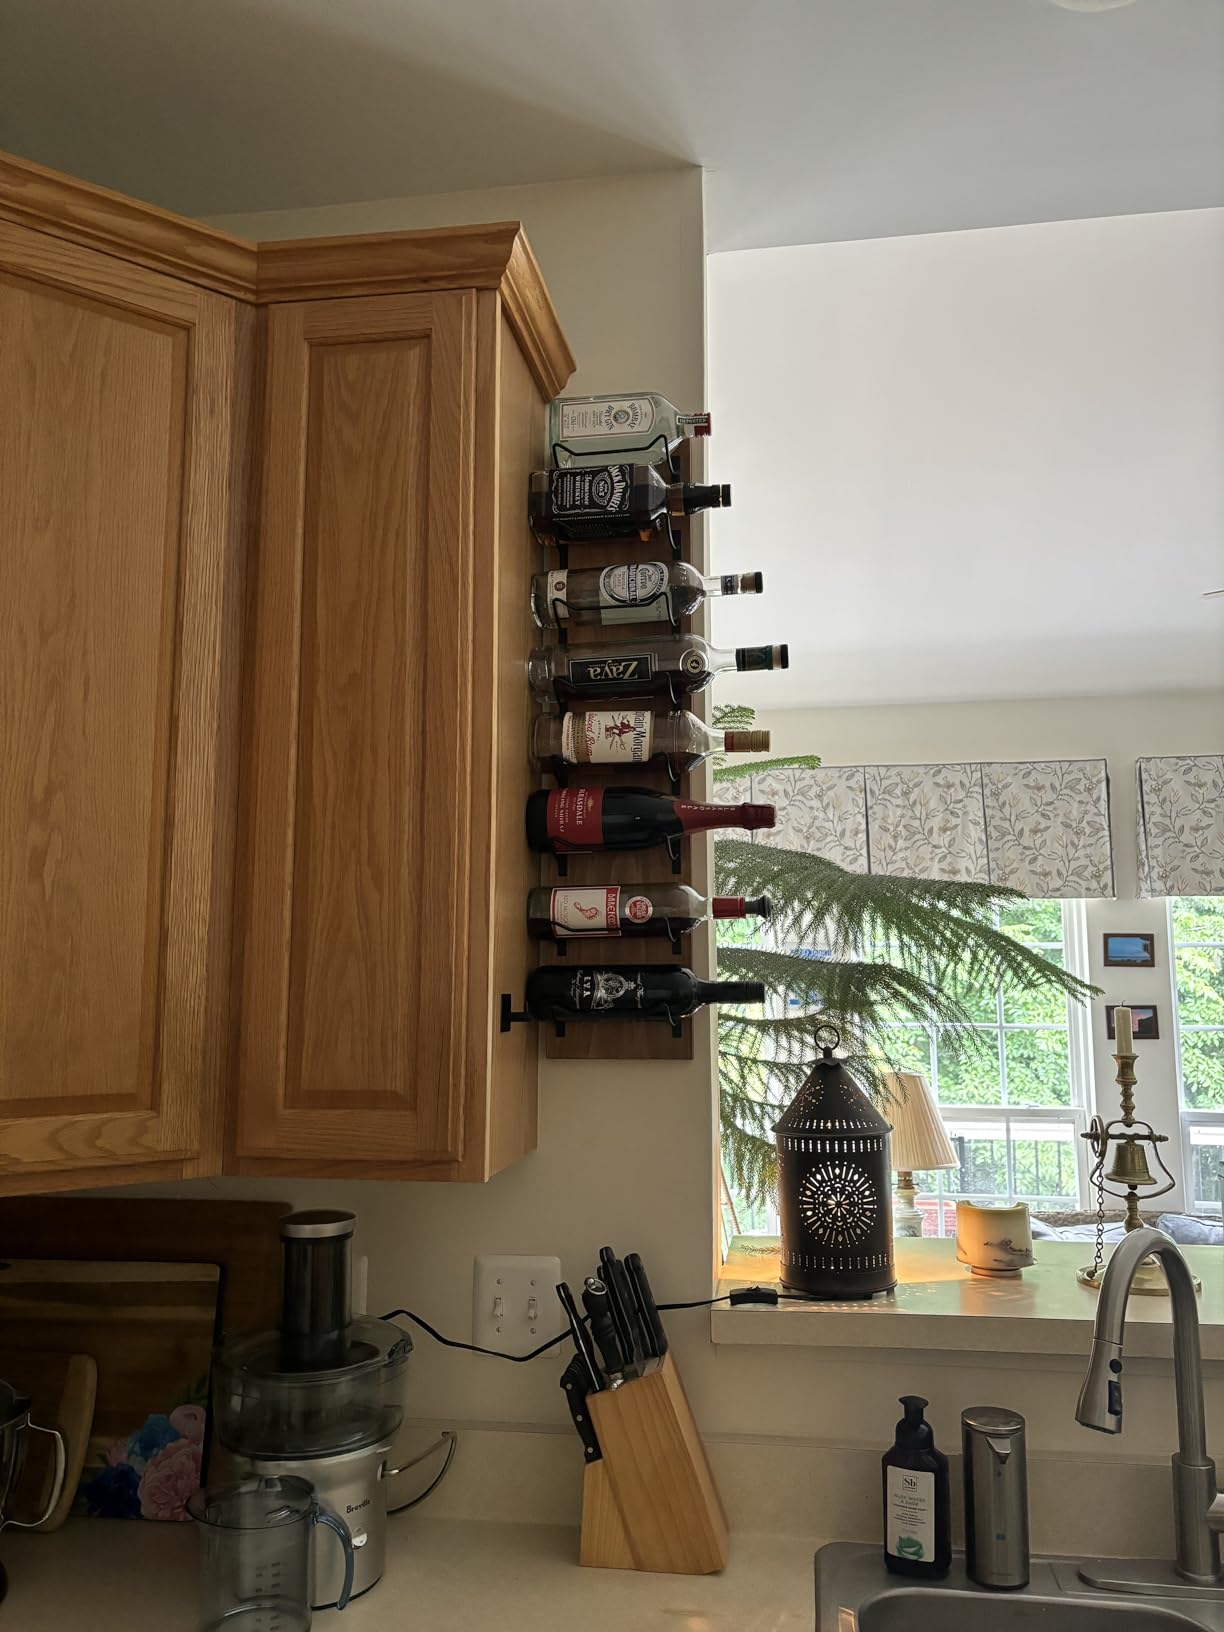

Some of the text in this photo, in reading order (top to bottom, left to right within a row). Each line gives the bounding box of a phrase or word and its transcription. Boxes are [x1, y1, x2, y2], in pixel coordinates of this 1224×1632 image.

[604, 404, 615, 431] DRY GIN
[627, 402, 640, 430] BOMBAY
[606, 465, 626, 512] JACK DANIEL'S
[587, 660, 638, 680] Zaya
[630, 729, 646, 762] Morgan
[904, 1478, 916, 1488] Sb
